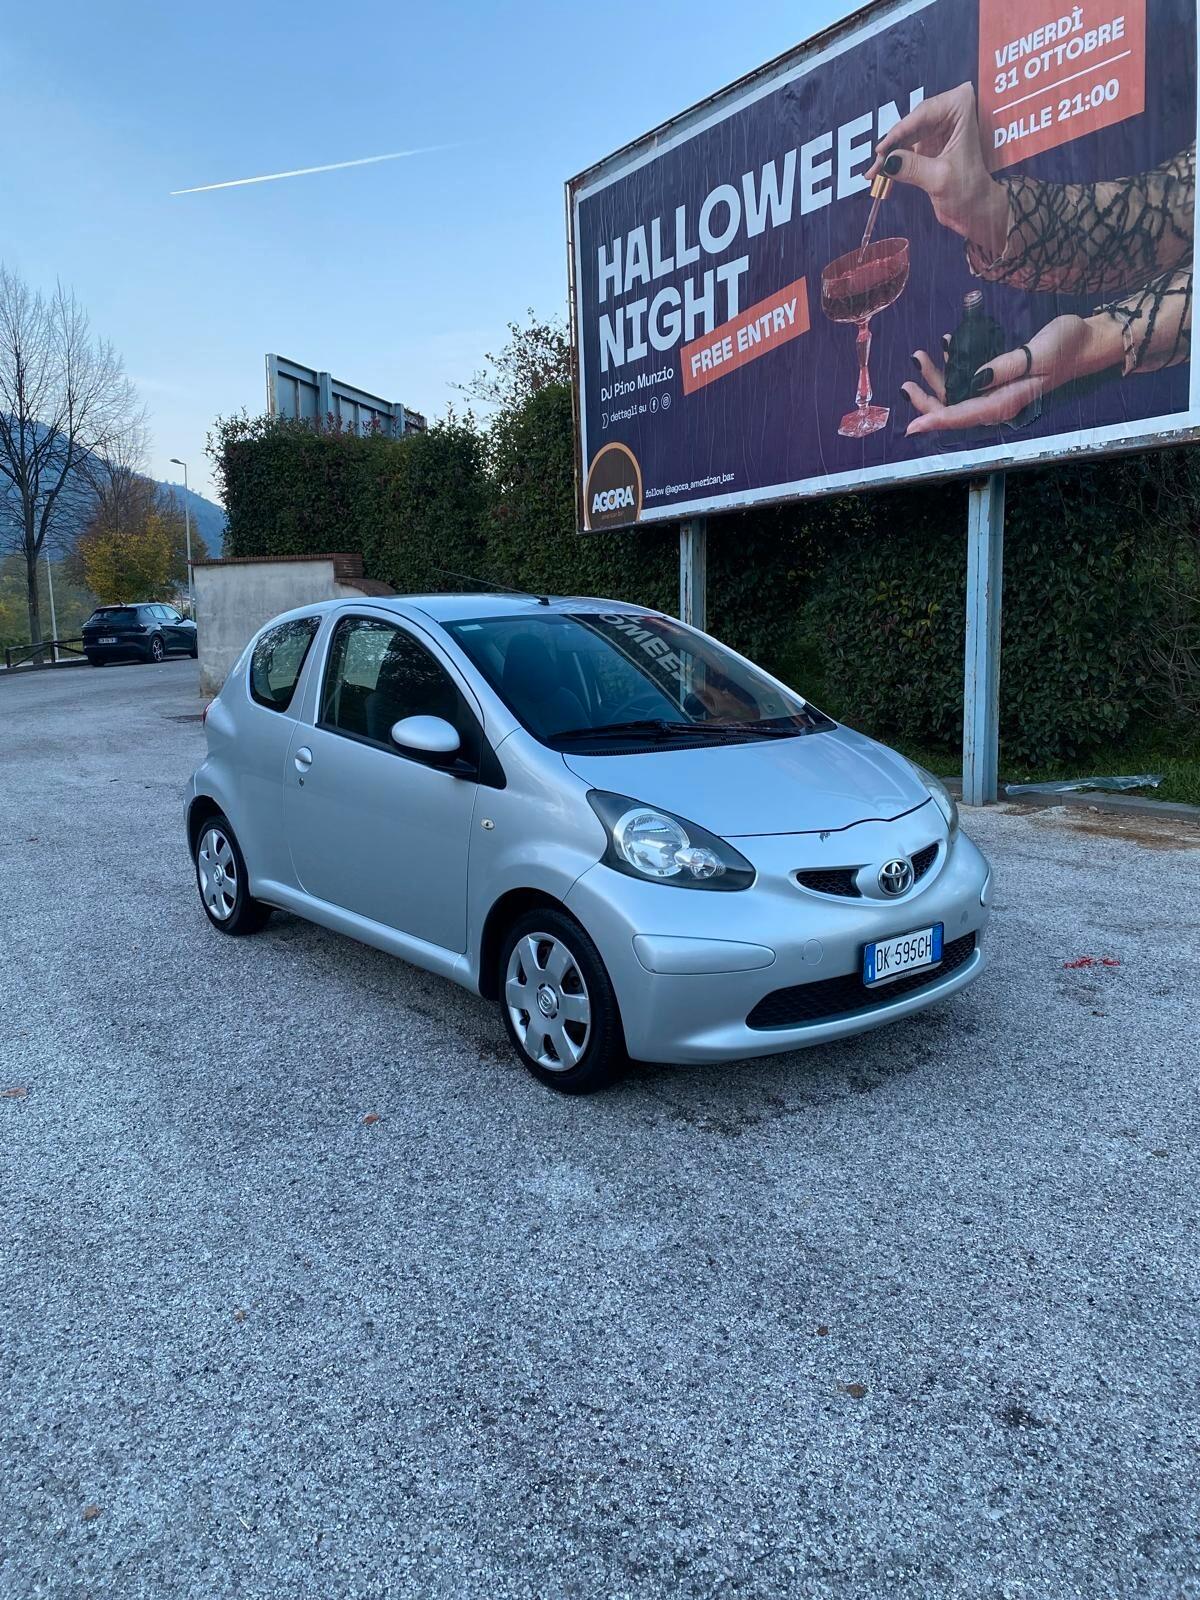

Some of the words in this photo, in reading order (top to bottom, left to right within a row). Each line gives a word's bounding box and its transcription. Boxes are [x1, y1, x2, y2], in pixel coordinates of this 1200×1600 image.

[994, 67, 1020, 93] 31
[1024, 15, 1125, 79] OTTOBRE
[995, 6, 1084, 68] VENERDÌ
[994, 106, 1053, 149] DALLE
[1057, 78, 1120, 121] 21:00
[599, 255, 749, 372] NIGHT
[691, 336, 733, 377] FREE
[737, 298, 797, 353] ENTRY
[600, 385, 613, 402] DJ
[614, 380, 636, 397] Pino
[637, 366, 674, 389] Munzio
[610, 404, 638, 422] dettagli
[638, 404, 647, 414] su
[645, 487, 664, 498] follow
[665, 473, 735, 496] @agora_american_bar
[876, 945, 891, 972] DK
[894, 934, 932, 965] 595GH
